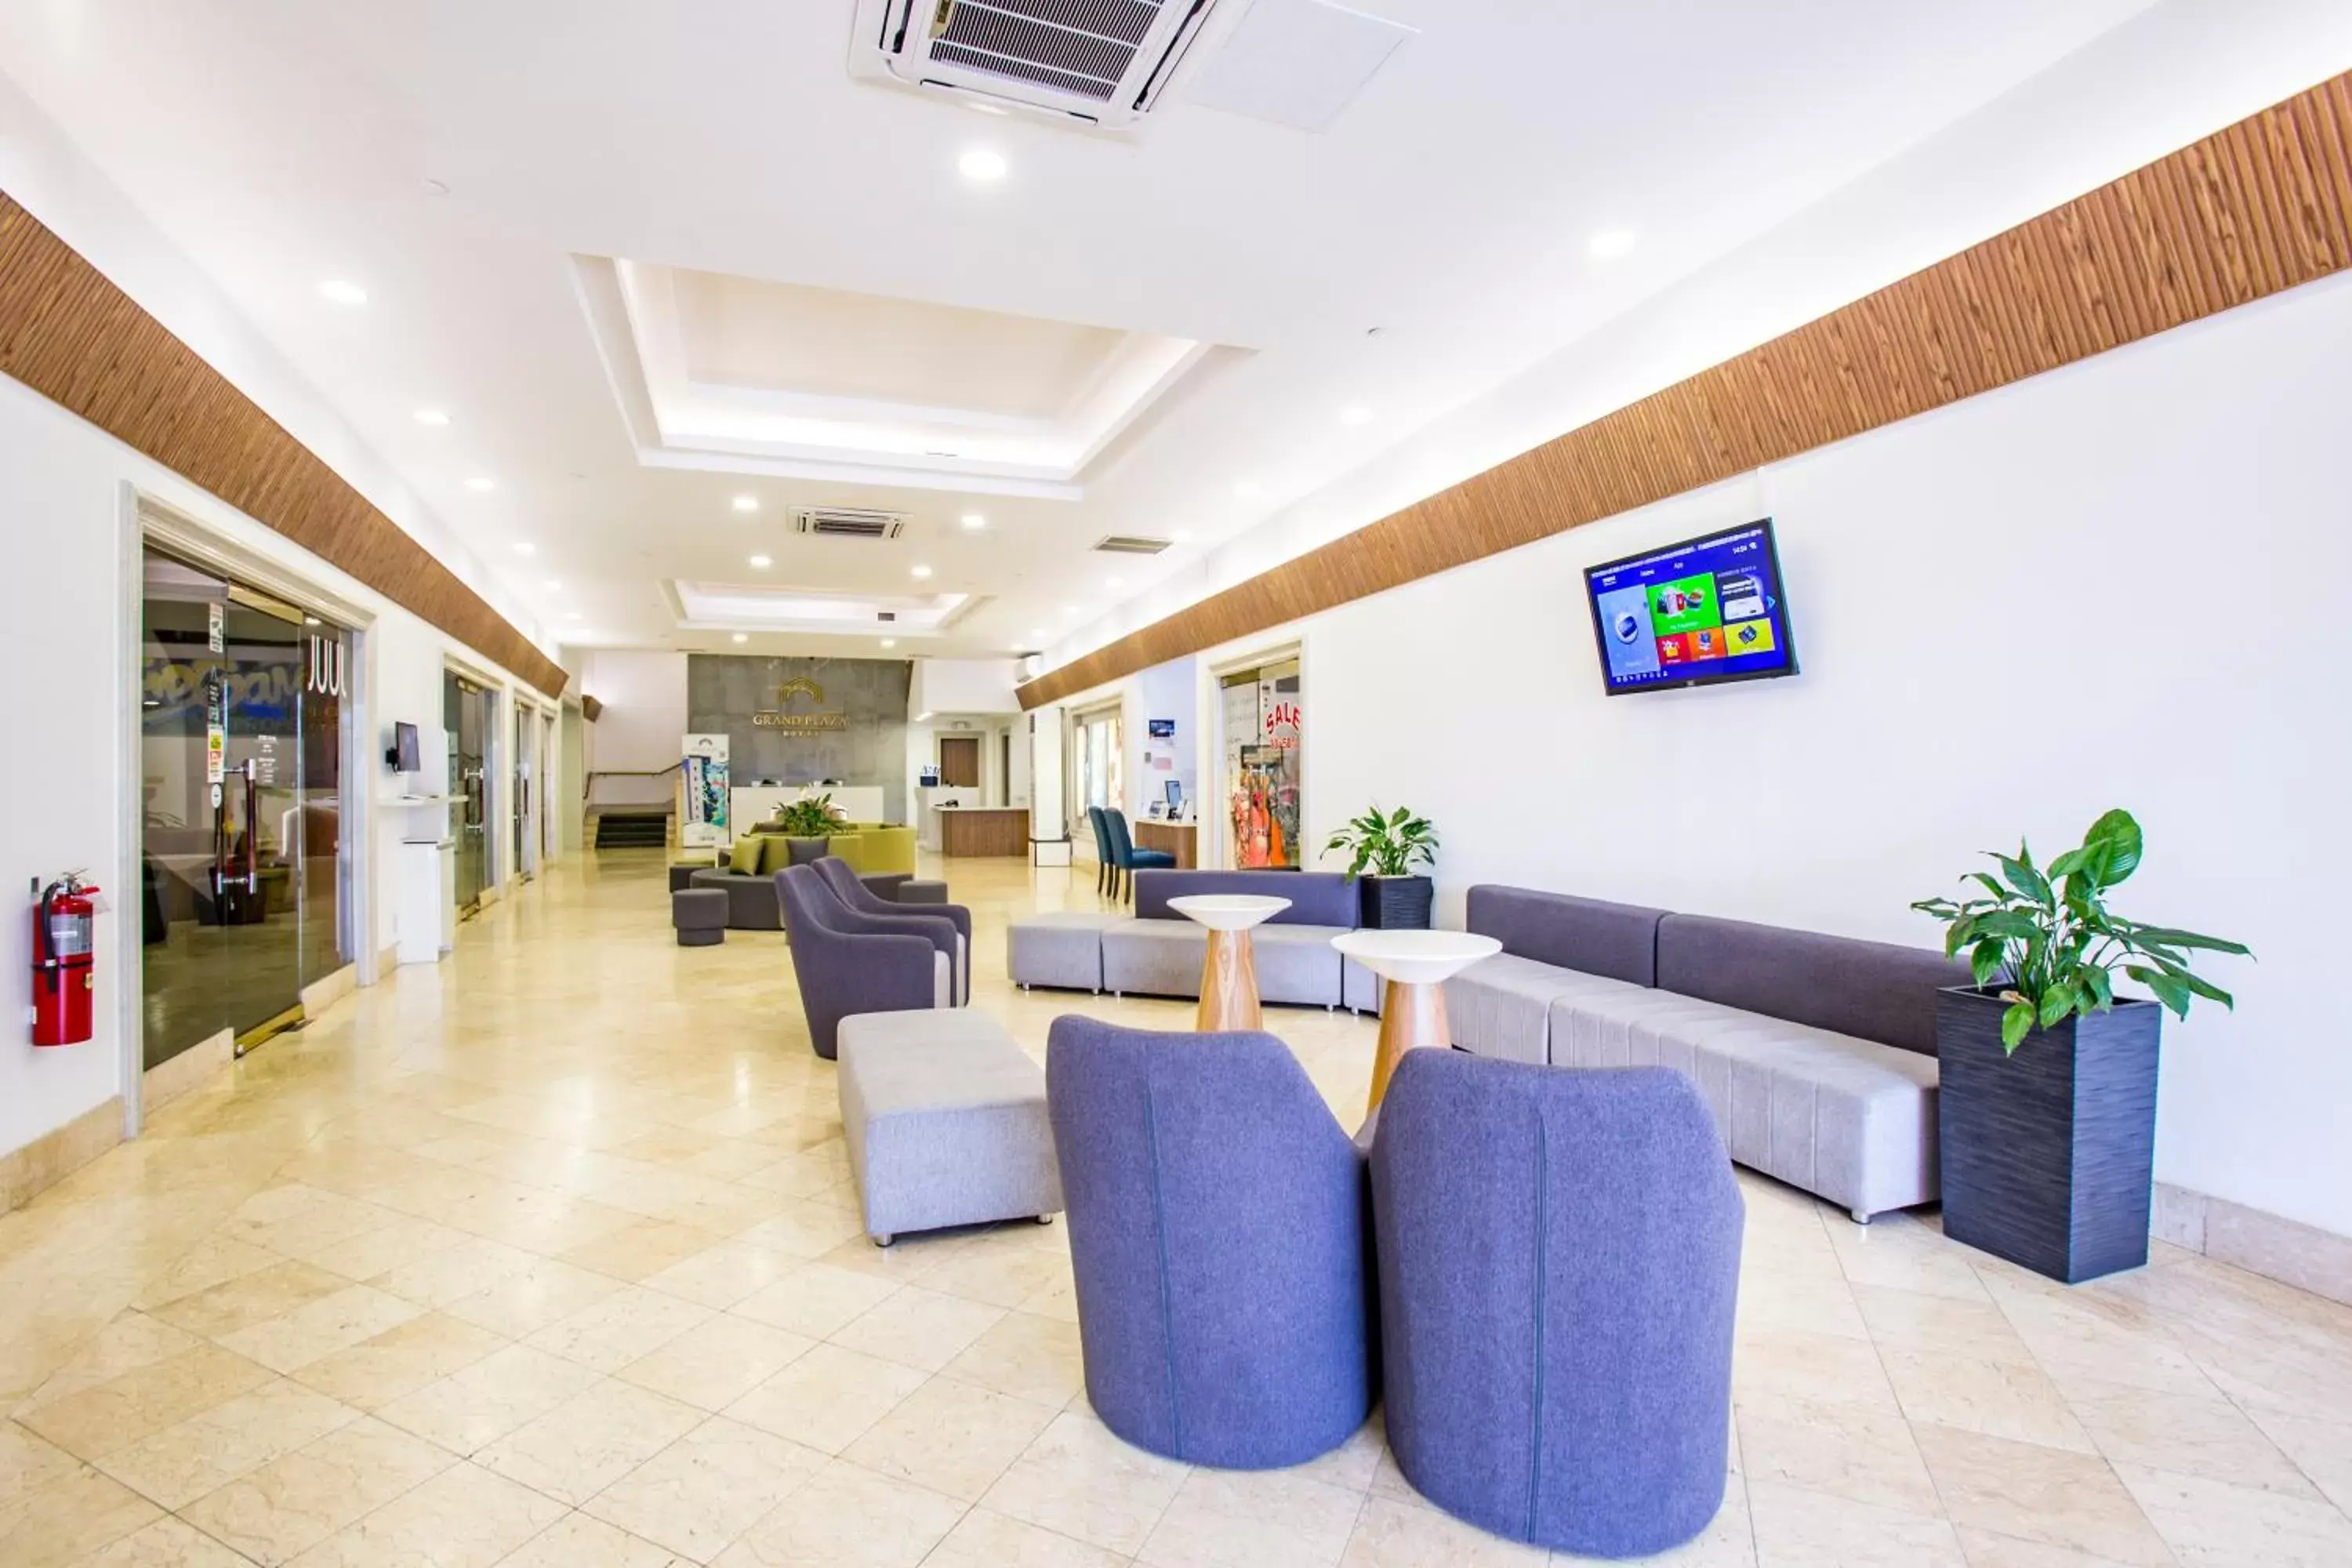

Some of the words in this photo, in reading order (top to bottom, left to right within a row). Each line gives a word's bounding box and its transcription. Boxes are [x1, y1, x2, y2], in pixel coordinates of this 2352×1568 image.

[753, 714, 800, 726] GRAND
[804, 714, 849, 726] PLAZA
[1266, 702, 1301, 734] SALE
